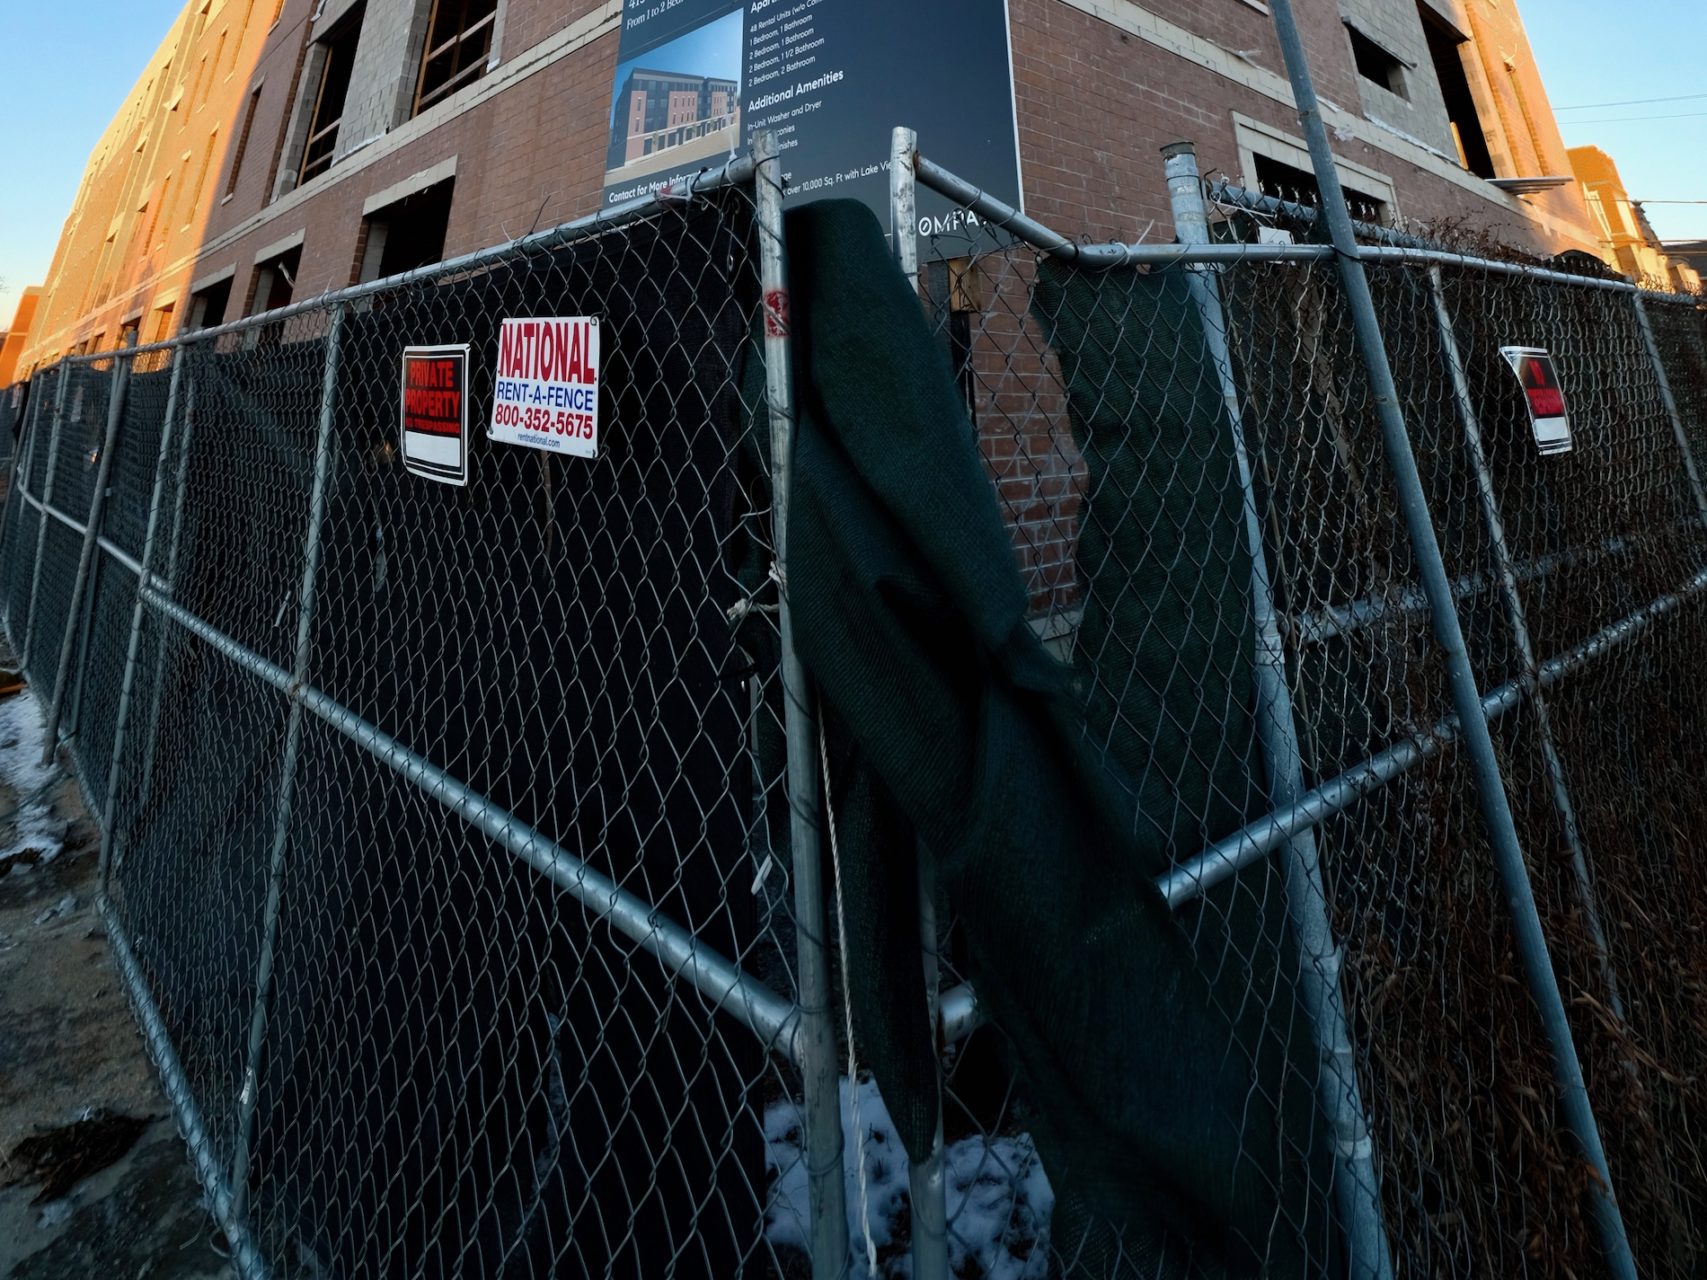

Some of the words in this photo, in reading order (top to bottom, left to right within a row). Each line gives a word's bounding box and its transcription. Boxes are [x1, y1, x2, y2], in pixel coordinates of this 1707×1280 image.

[626, 14, 646, 30] From
[646, 9, 651, 20] 1
[651, 6, 660, 17] to
[660, 1, 666, 13] 2
[750, 24, 758, 33] 48
[758, 16, 776, 30] Rental
[776, 9, 791, 21] Units
[792, 3, 805, 16] (w/o
[753, 29, 779, 46] Bedroom,
[784, 14, 813, 32] Bathroom
[748, 65, 753, 73] 2
[753, 56, 780, 72] Bedroom,
[785, 48, 793, 58] 1/2
[795, 38, 824, 55] Bathroom
[749, 52, 753, 60] 2
[754, 43, 780, 58] Bedroom,
[785, 27, 814, 46] Bathroom
[748, 79, 753, 87] 2
[753, 70, 780, 86] Bedroom,
[781, 66, 785, 75] 2
[786, 56, 816, 72] Bathroom
[748, 85, 793, 112] Additional
[795, 70, 844, 96] Amenities
[747, 119, 767, 131] In-Unit
[767, 111, 790, 125] Washer
[791, 105, 804, 116] and
[805, 100, 822, 112] Dryer
[608, 190, 636, 203] Contact
[636, 184, 647, 196] for
[648, 180, 668, 193] More
[787, 186, 800, 195] over
[824, 176, 834, 187] Sq.
[843, 169, 859, 181] with
[860, 165, 879, 177] Lake
[500, 322, 595, 384] NATIONAL
[410, 360, 454, 388] PRIVATE
[405, 388, 460, 418] PROPERTY
[496, 381, 593, 411] RENT-A-FENCE
[495, 403, 593, 440] 800-352-5675
[517, 432, 561, 449] rentnational.com
